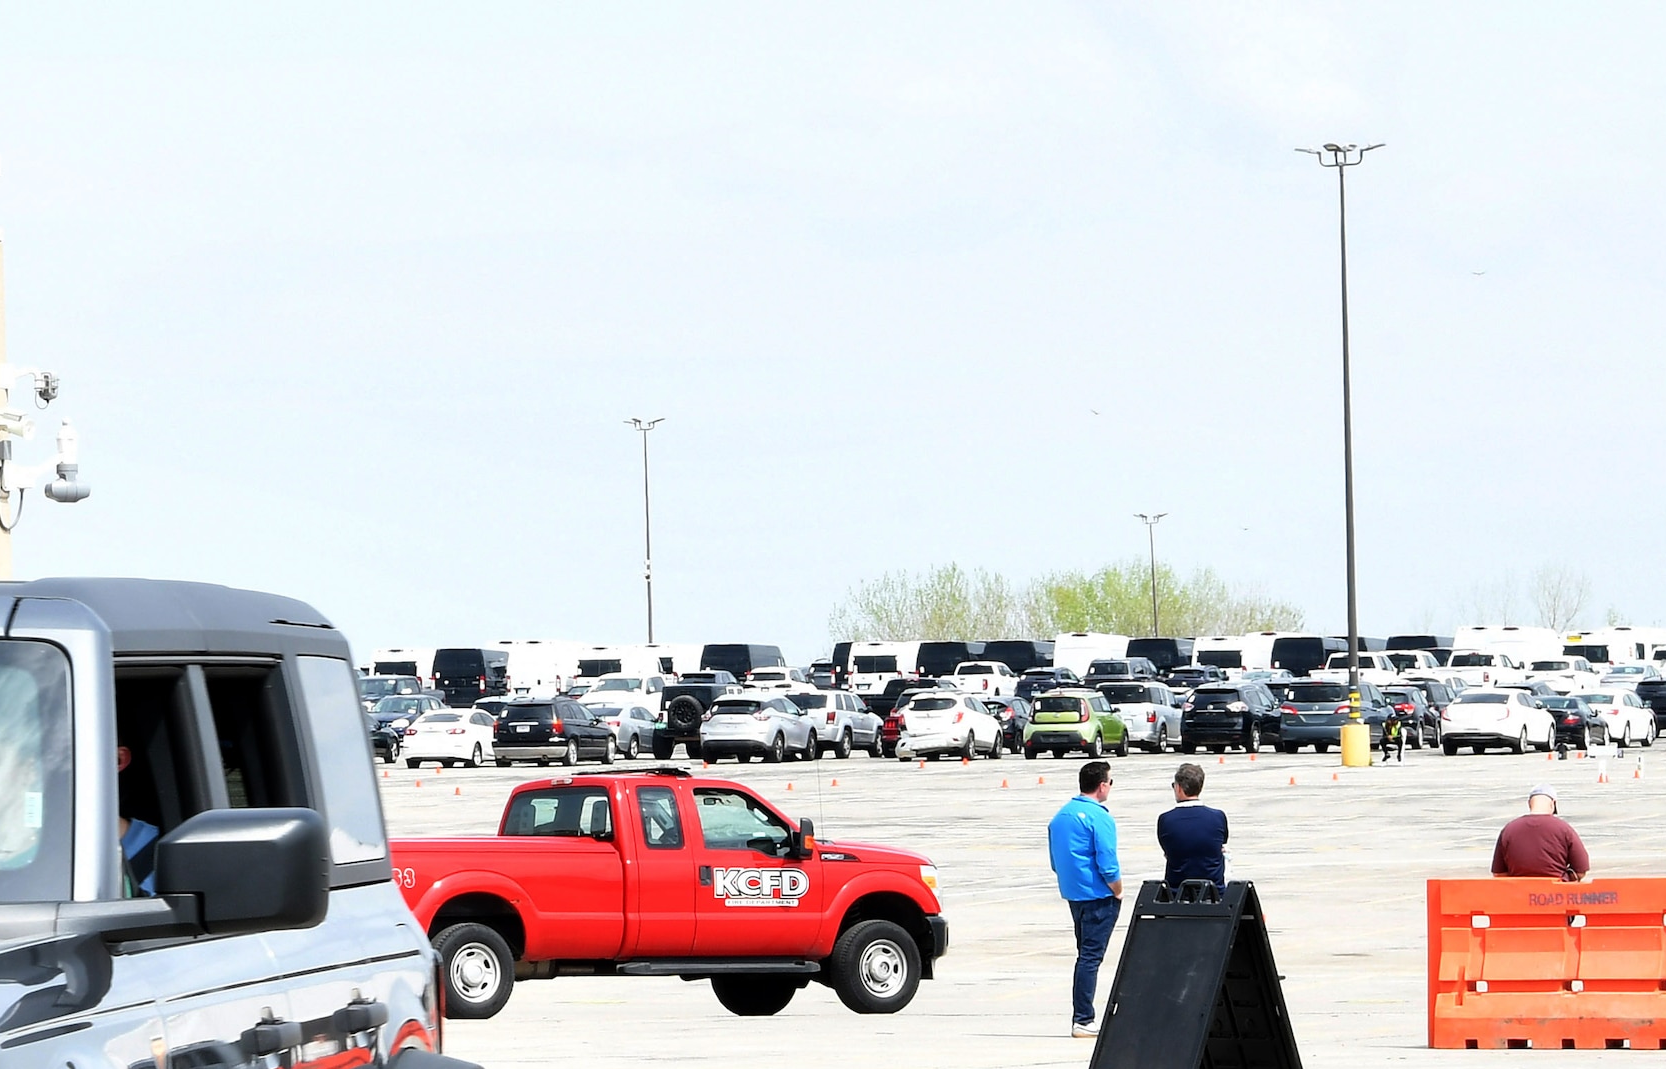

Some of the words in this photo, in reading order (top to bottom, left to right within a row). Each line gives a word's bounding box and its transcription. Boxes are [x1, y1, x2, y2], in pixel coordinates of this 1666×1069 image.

[714, 868, 809, 898] KCFD
[1529, 893, 1564, 906] ROAD
[1566, 891, 1618, 905] RUNNER
